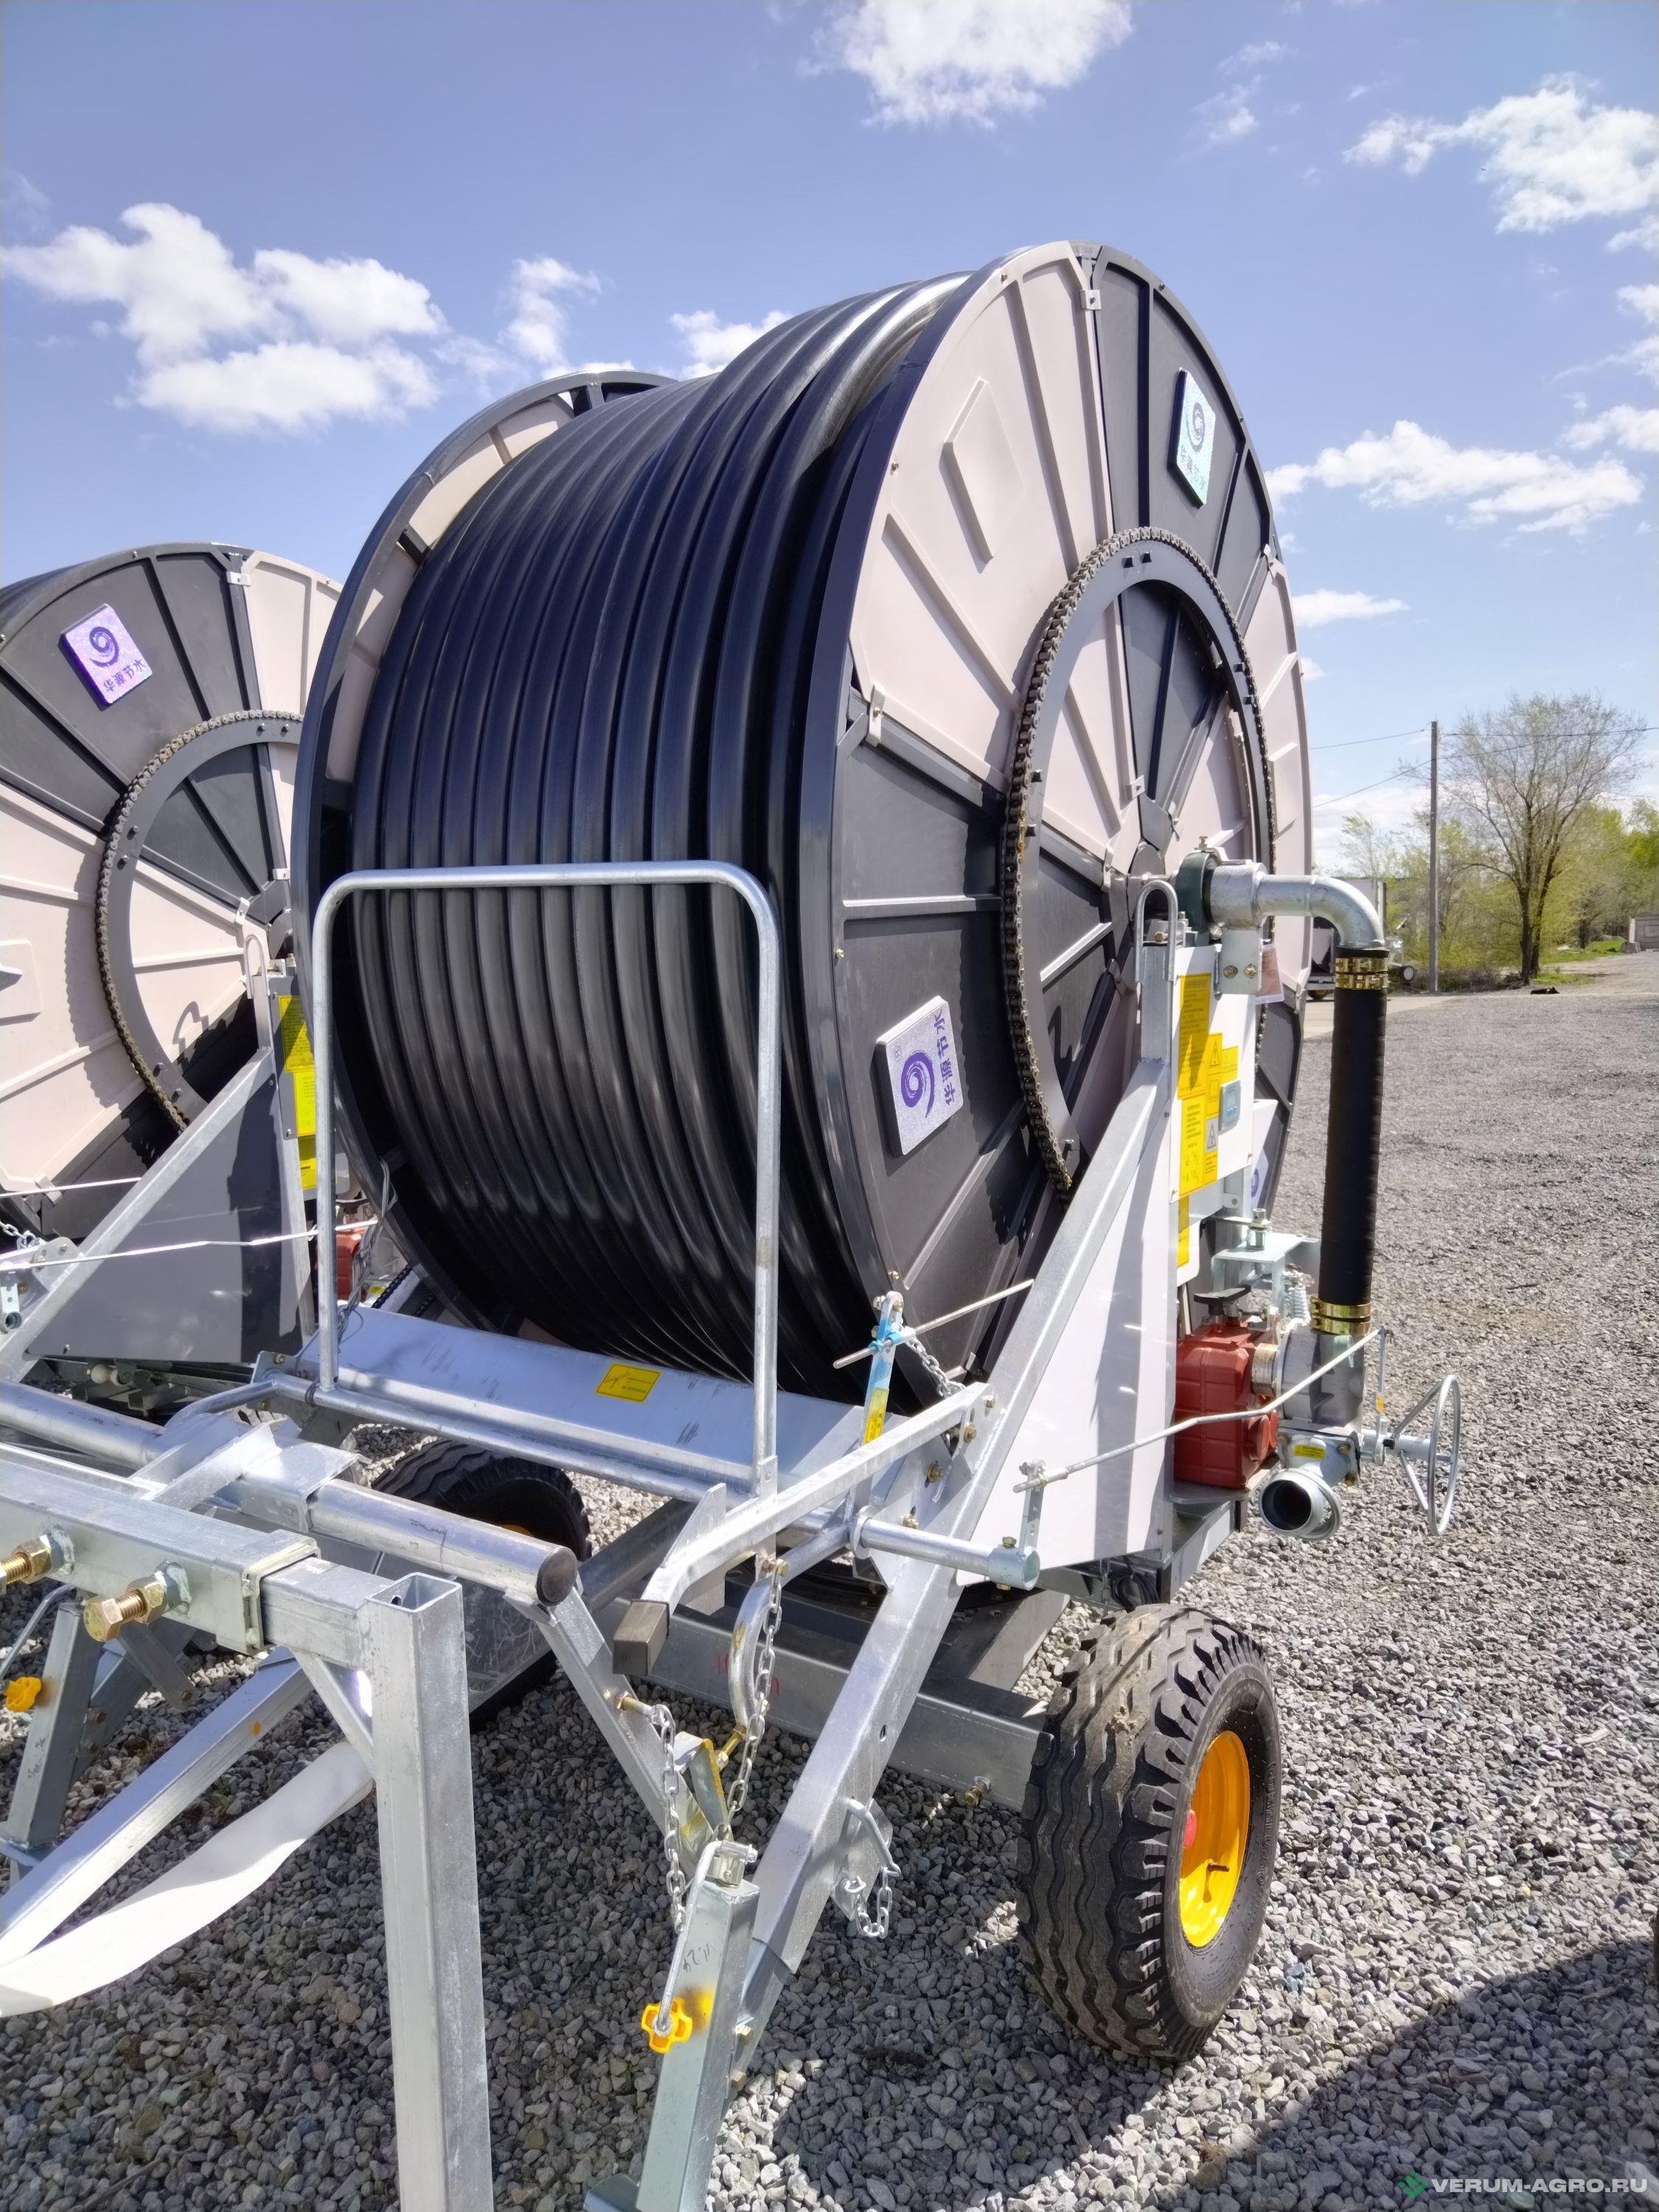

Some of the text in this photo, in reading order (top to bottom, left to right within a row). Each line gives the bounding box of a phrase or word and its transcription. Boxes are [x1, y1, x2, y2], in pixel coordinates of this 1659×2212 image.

[102, 658, 147, 693] 华源节水
[933, 1008, 956, 1106] 华源节水
